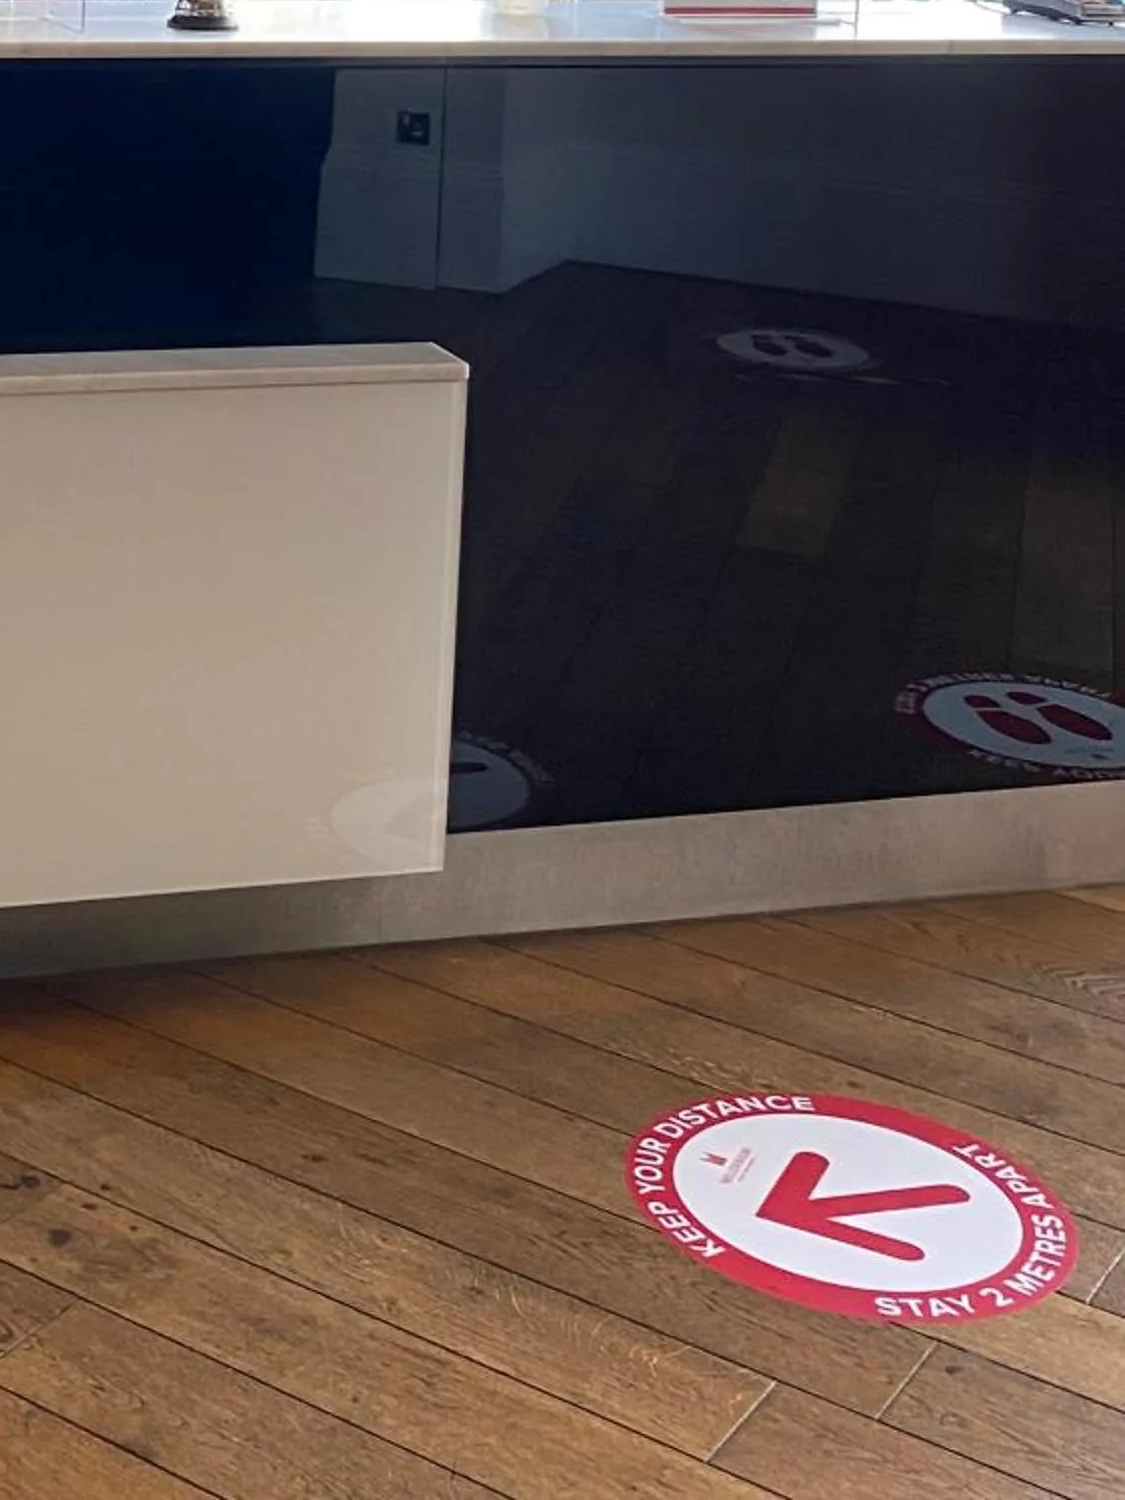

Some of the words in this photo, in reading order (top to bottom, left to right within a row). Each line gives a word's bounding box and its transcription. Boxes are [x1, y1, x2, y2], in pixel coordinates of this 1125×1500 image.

[659, 1095, 816, 1139] DISTANCE
[633, 1137, 670, 1196] YOUR
[948, 1141, 1053, 1210] APART
[648, 1204, 726, 1258] KEEP
[1013, 1214, 1066, 1297] METRES
[874, 1293, 976, 1318] STAY
[979, 1285, 1014, 1308] 2
